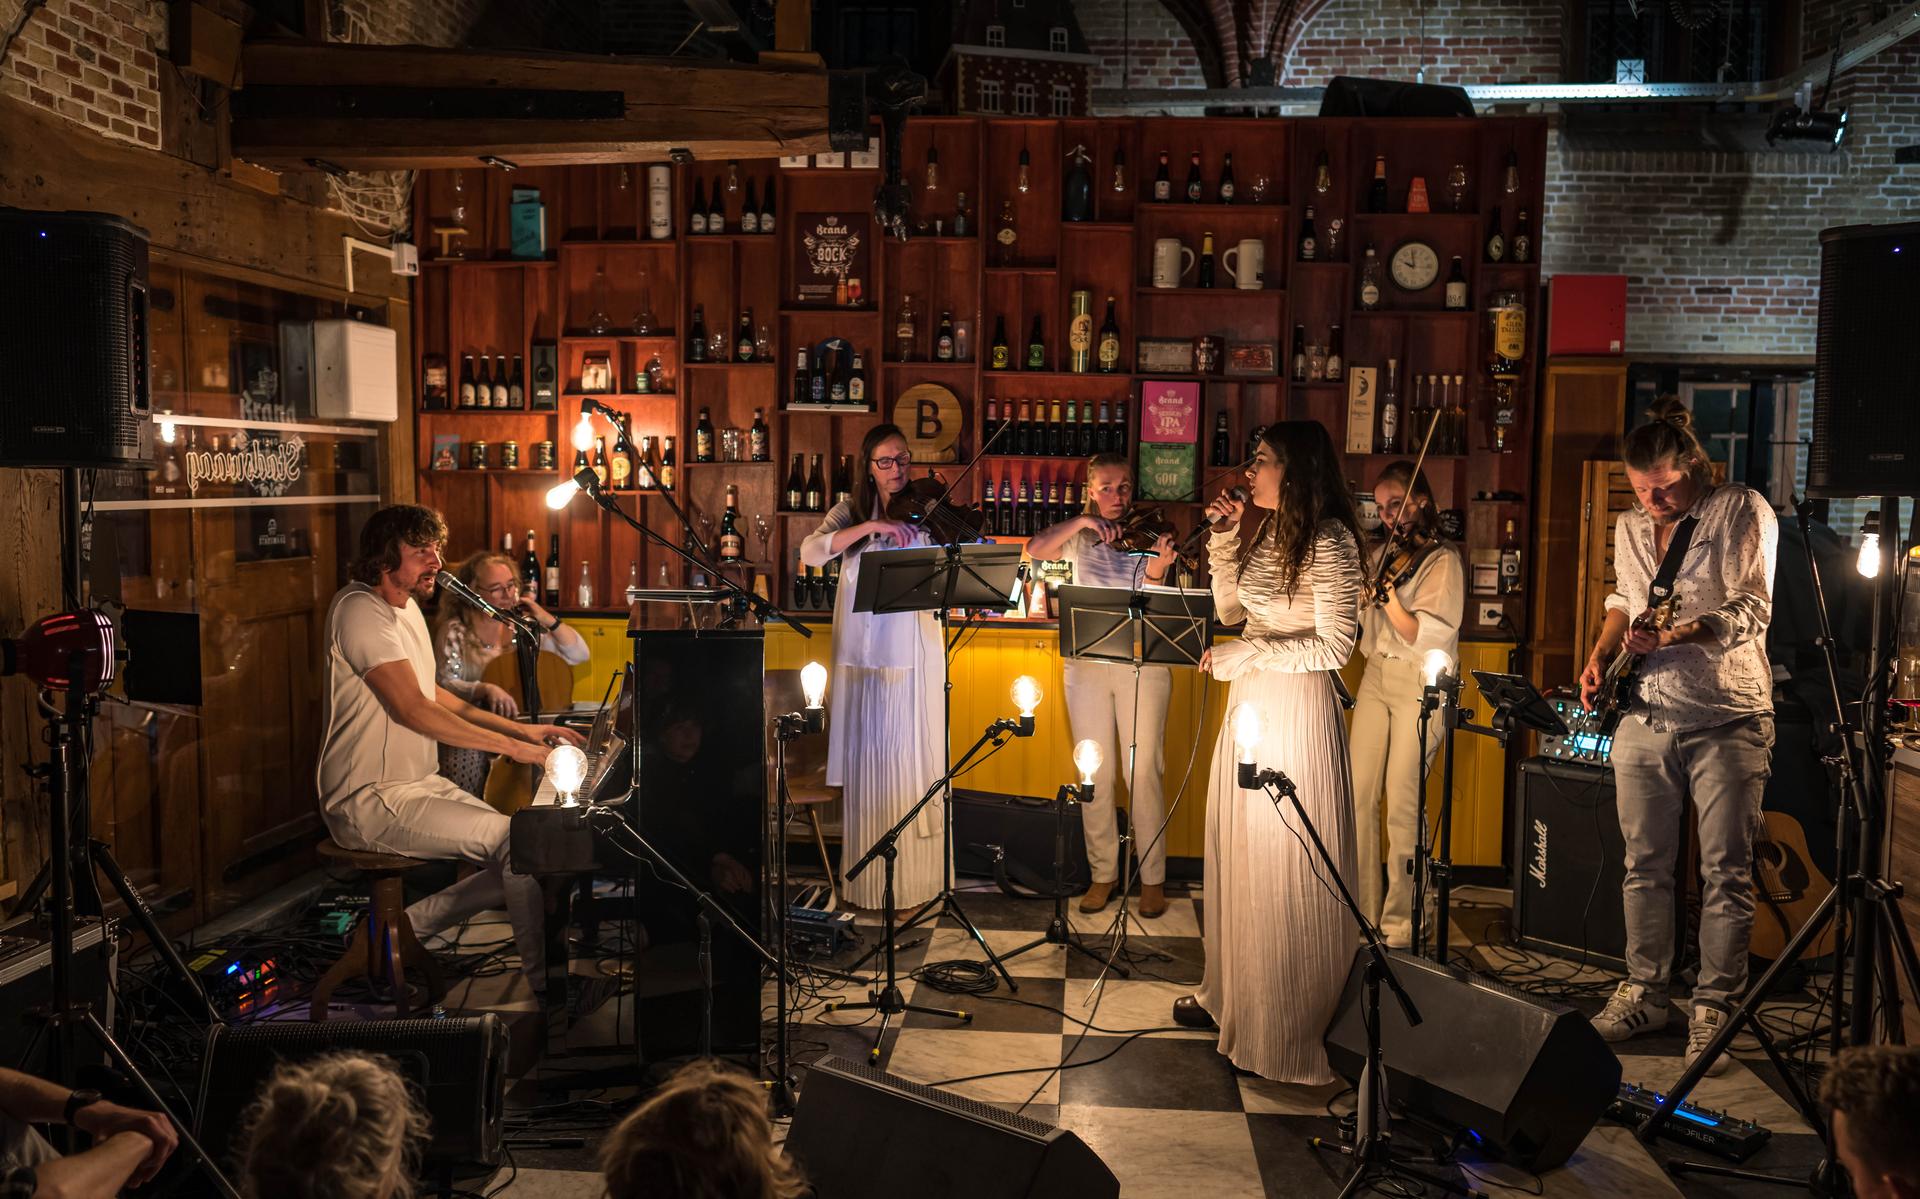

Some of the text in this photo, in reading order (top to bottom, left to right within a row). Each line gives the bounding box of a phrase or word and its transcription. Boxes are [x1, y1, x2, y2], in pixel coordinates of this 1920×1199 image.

[816, 224, 848, 236] Brand
[817, 247, 847, 262] BOCK
[1158, 395, 1184, 405] Brand
[917, 399, 942, 439] B
[1160, 416, 1180, 428] IPA
[1155, 456, 1180, 465] Brand
[1041, 560, 1070, 571] Brand
[1528, 818, 1548, 888] Marshall
